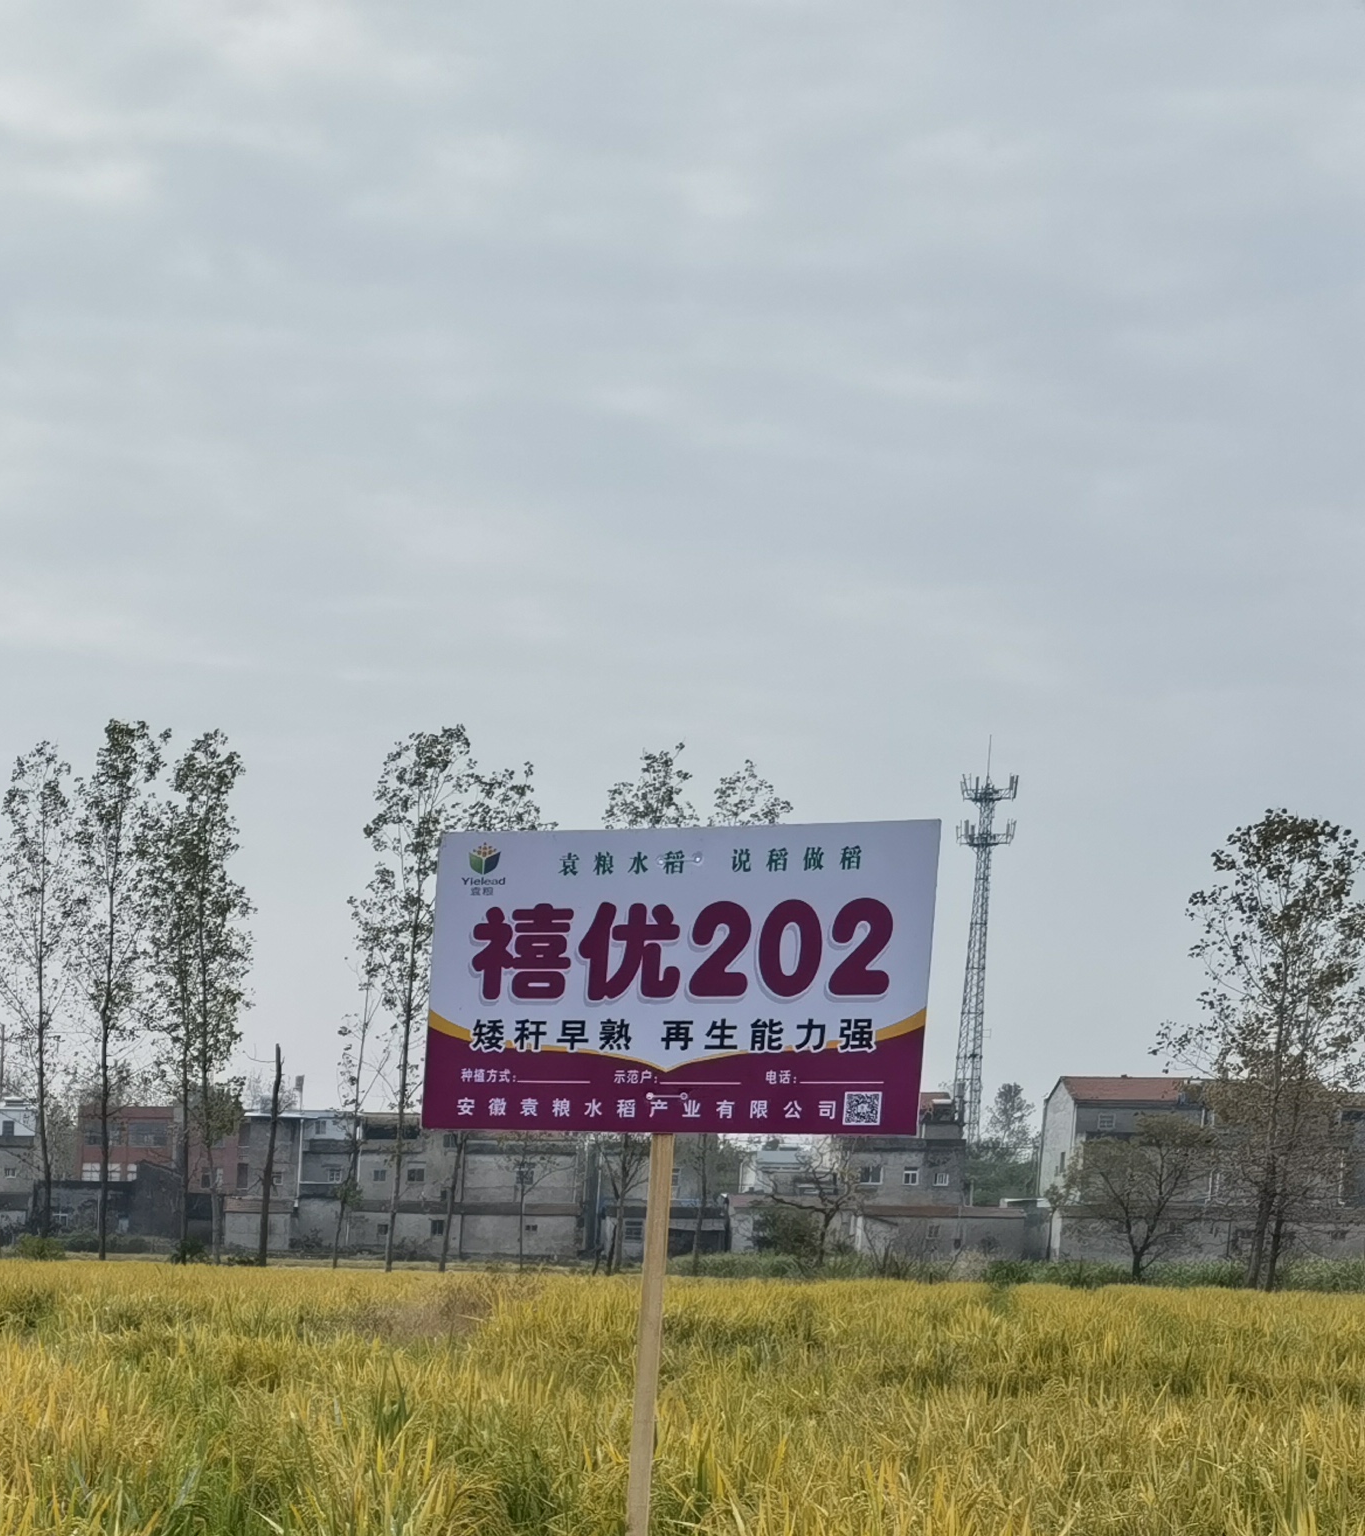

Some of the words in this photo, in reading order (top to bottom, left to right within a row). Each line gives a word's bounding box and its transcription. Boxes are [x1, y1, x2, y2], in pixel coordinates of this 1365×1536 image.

[558, 850, 685, 876] 袁粮水稻
[731, 845, 863, 873] 说稻做稻
[471, 897, 894, 1001] 禧优202
[471, 1018, 632, 1051] 矮秆早熟
[661, 1018, 874, 1051] 再生能力强
[456, 1097, 837, 1120] 安徽袁粮水稻产业有限公司
